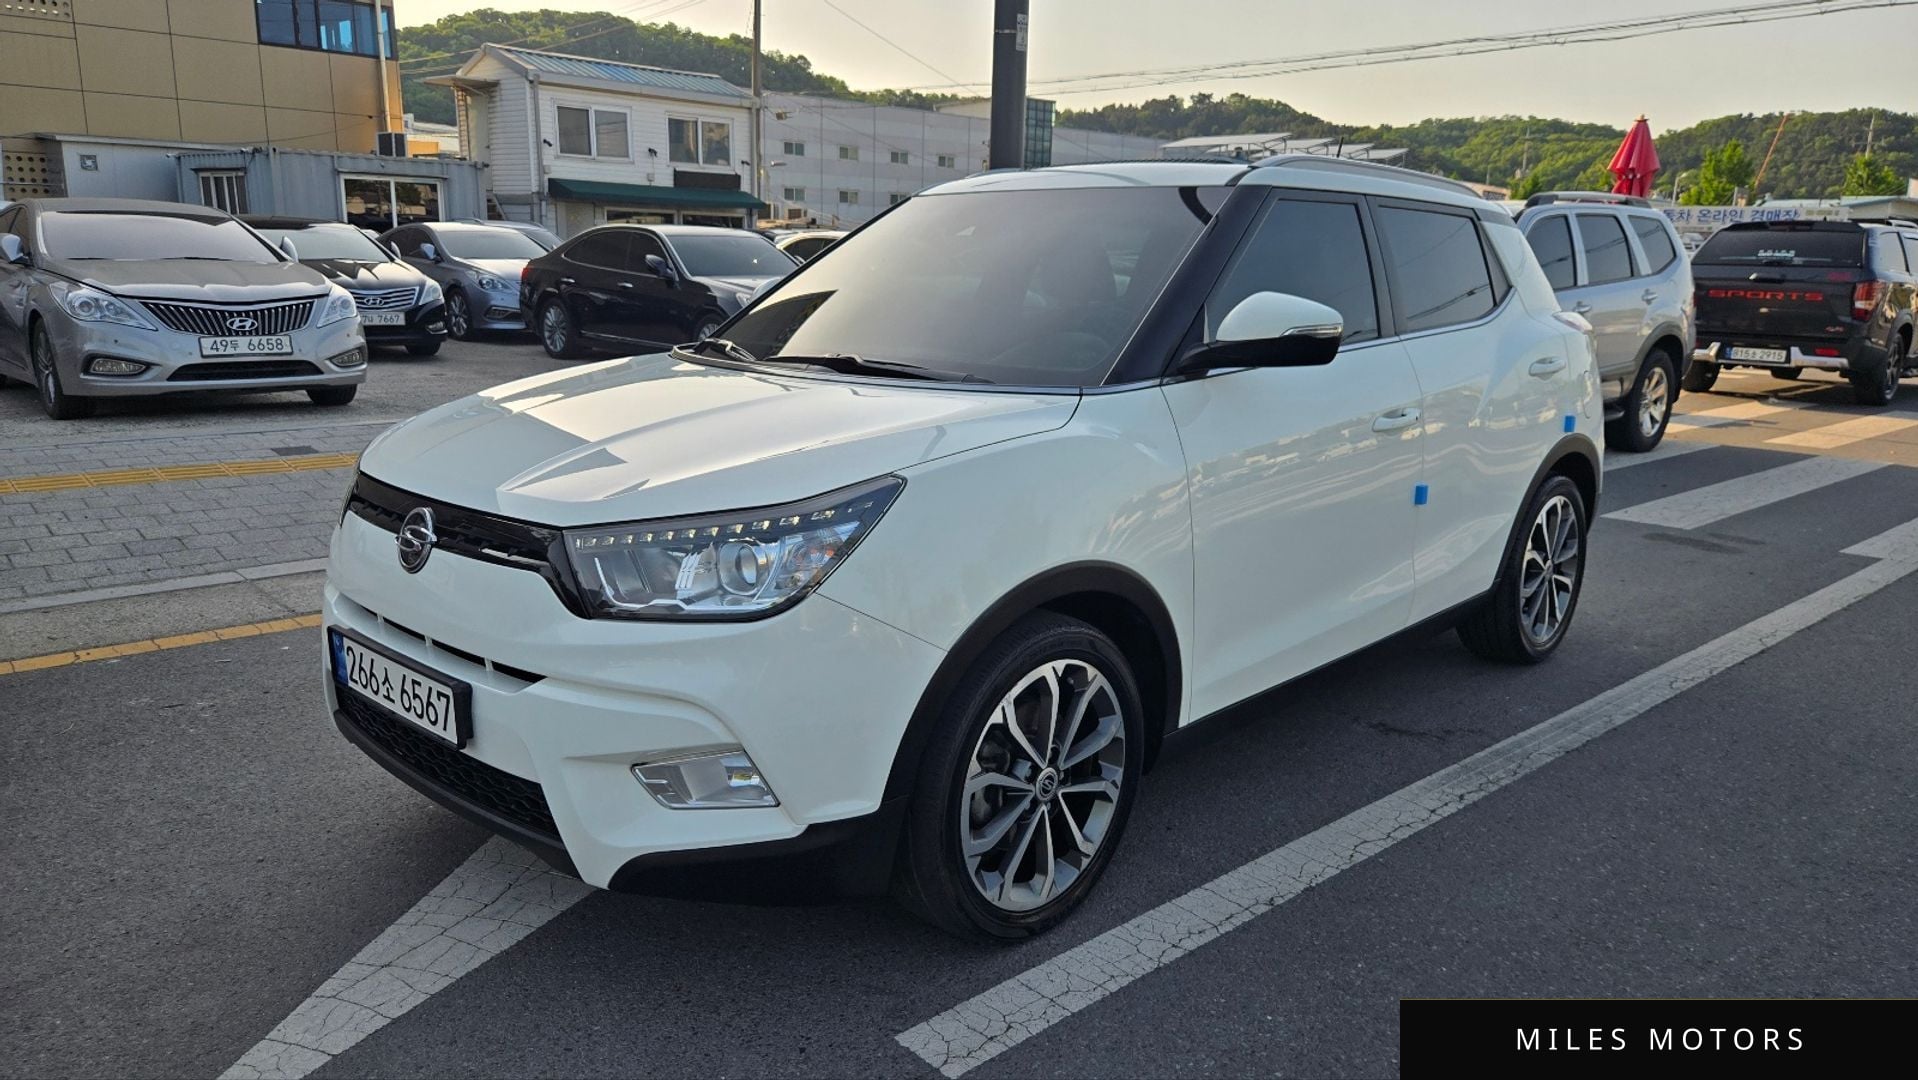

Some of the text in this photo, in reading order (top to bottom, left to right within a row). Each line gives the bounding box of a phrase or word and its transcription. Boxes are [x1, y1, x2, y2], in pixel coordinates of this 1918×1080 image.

[1696, 208, 1744, 224] 온라인
[1708, 289, 1824, 301] SPORTS
[377, 314, 400, 323] 7667
[210, 337, 284, 353] 49두 6658
[346, 645, 450, 732] 266소 6567
